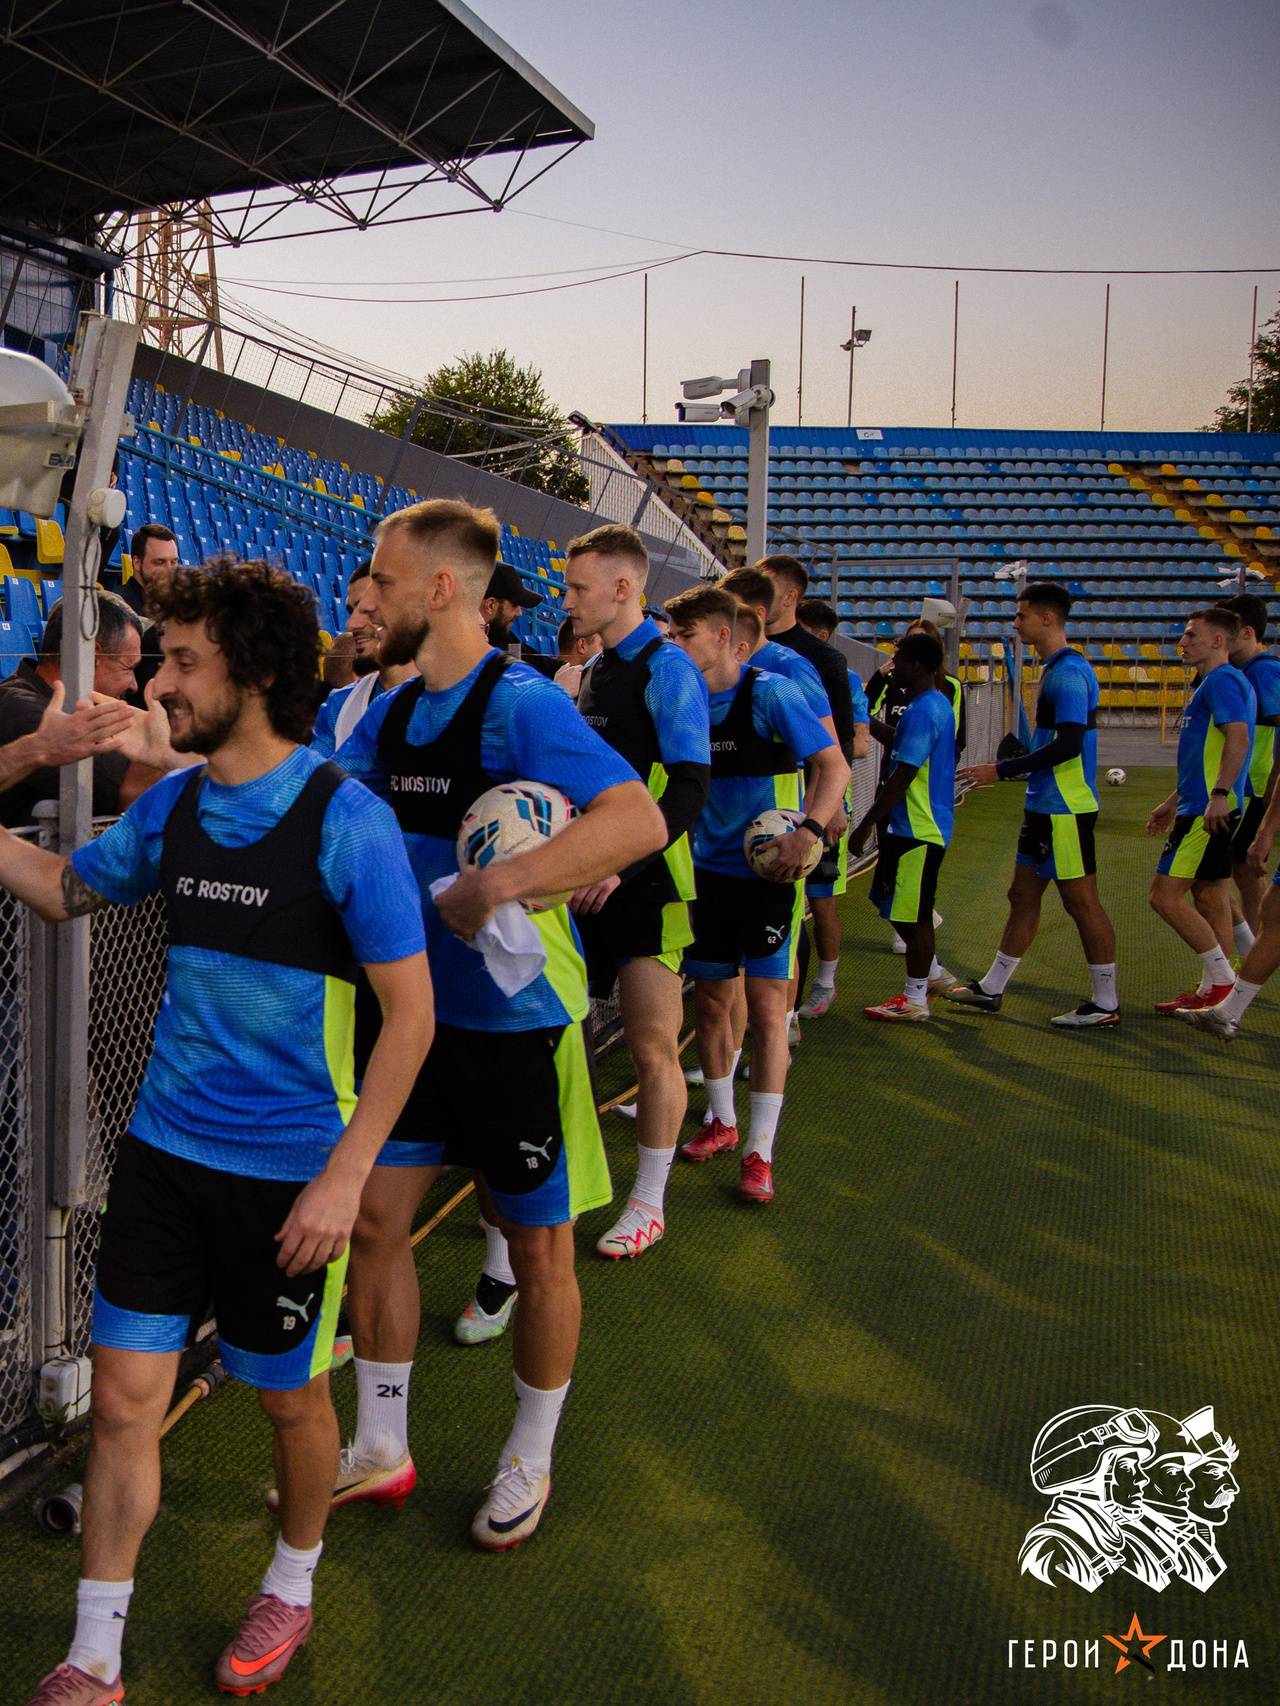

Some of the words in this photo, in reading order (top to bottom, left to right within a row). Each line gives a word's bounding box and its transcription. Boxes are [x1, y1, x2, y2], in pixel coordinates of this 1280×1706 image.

[400, 775, 452, 795] ROSTOV
[176, 876, 195, 896] FC
[197, 879, 270, 907] ROSTOV
[767, 936, 777, 944] 62
[525, 1156, 539, 1169] 18
[283, 1315, 297, 1330] 19
[376, 1383, 405, 1398] 2K
